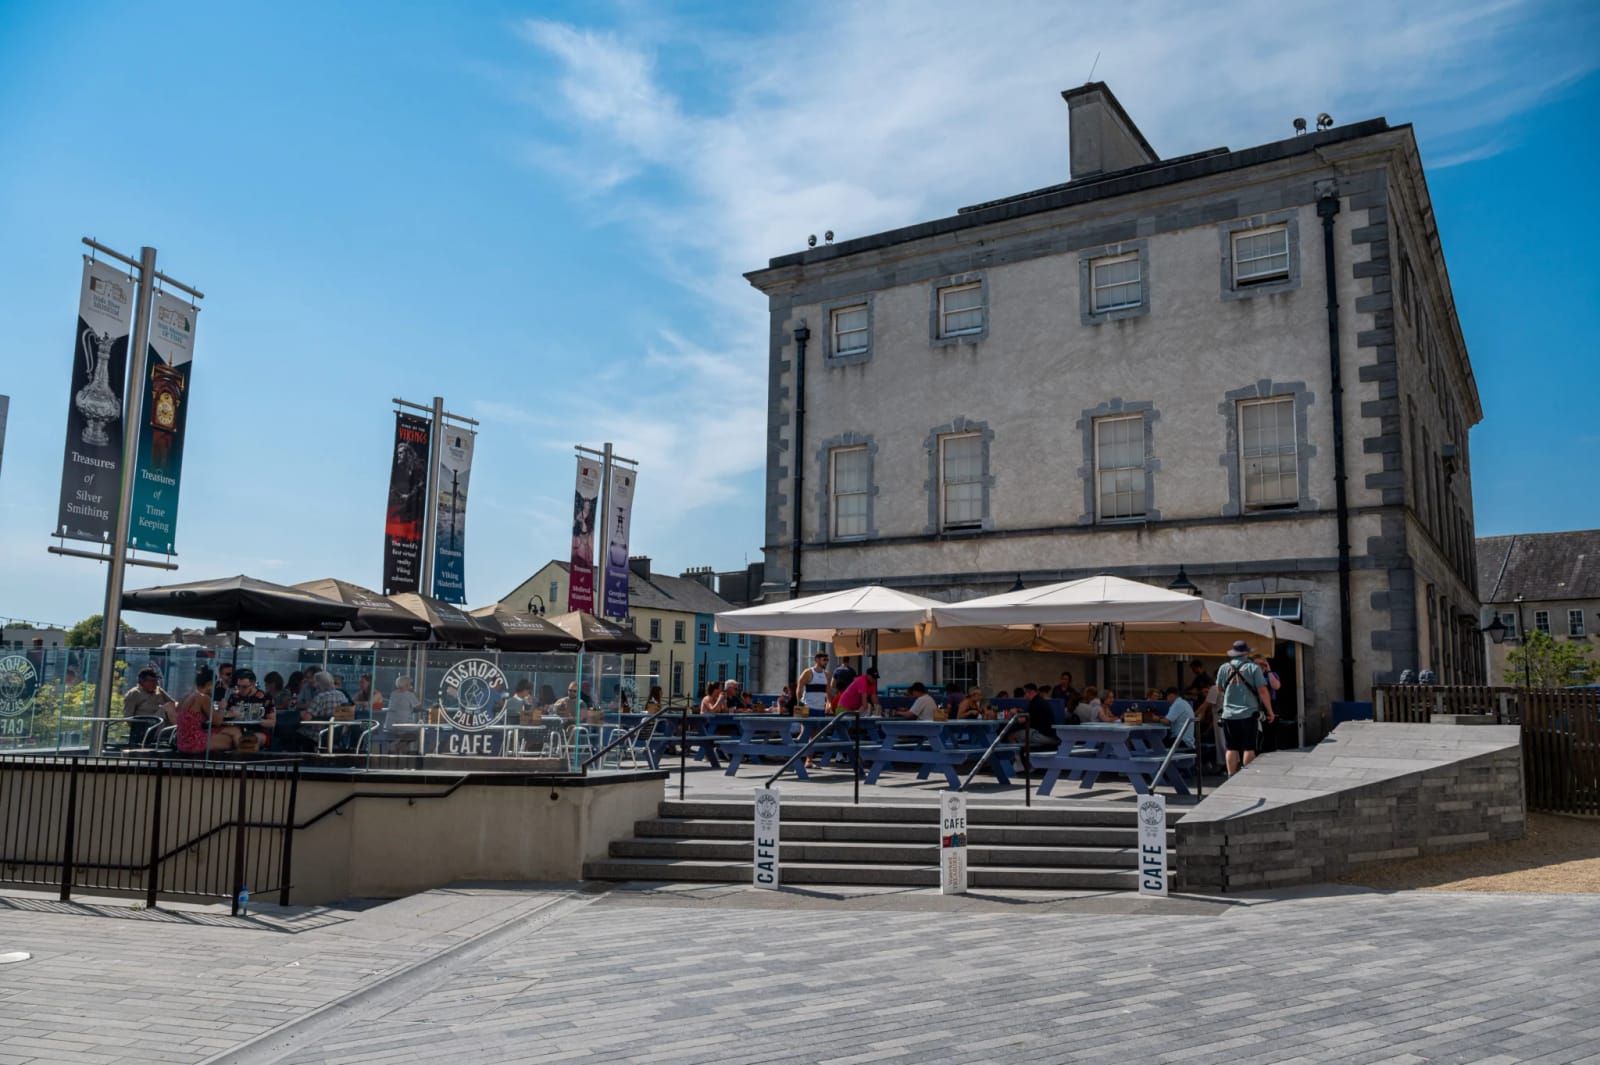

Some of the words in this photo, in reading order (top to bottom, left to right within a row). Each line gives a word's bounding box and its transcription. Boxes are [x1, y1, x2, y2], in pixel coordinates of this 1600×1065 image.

[399, 427, 428, 444] VIKINGS
[72, 451, 116, 470] Treasures
[84, 473, 95, 486] of
[141, 469, 176, 486] Treasures
[76, 489, 102, 504] Silver
[153, 489, 162, 500] of
[66, 502, 109, 520] Smithing
[145, 504, 165, 517] Time
[139, 517, 169, 533] Keeping
[441, 571, 459, 581] Viking
[445, 661, 504, 688] BISHOP'S
[452, 710, 492, 726] PALACE
[449, 734, 493, 753] CAFE
[944, 818, 965, 829] CAFE
[757, 838, 775, 884] CAFE
[1143, 844, 1162, 890] CAFE
